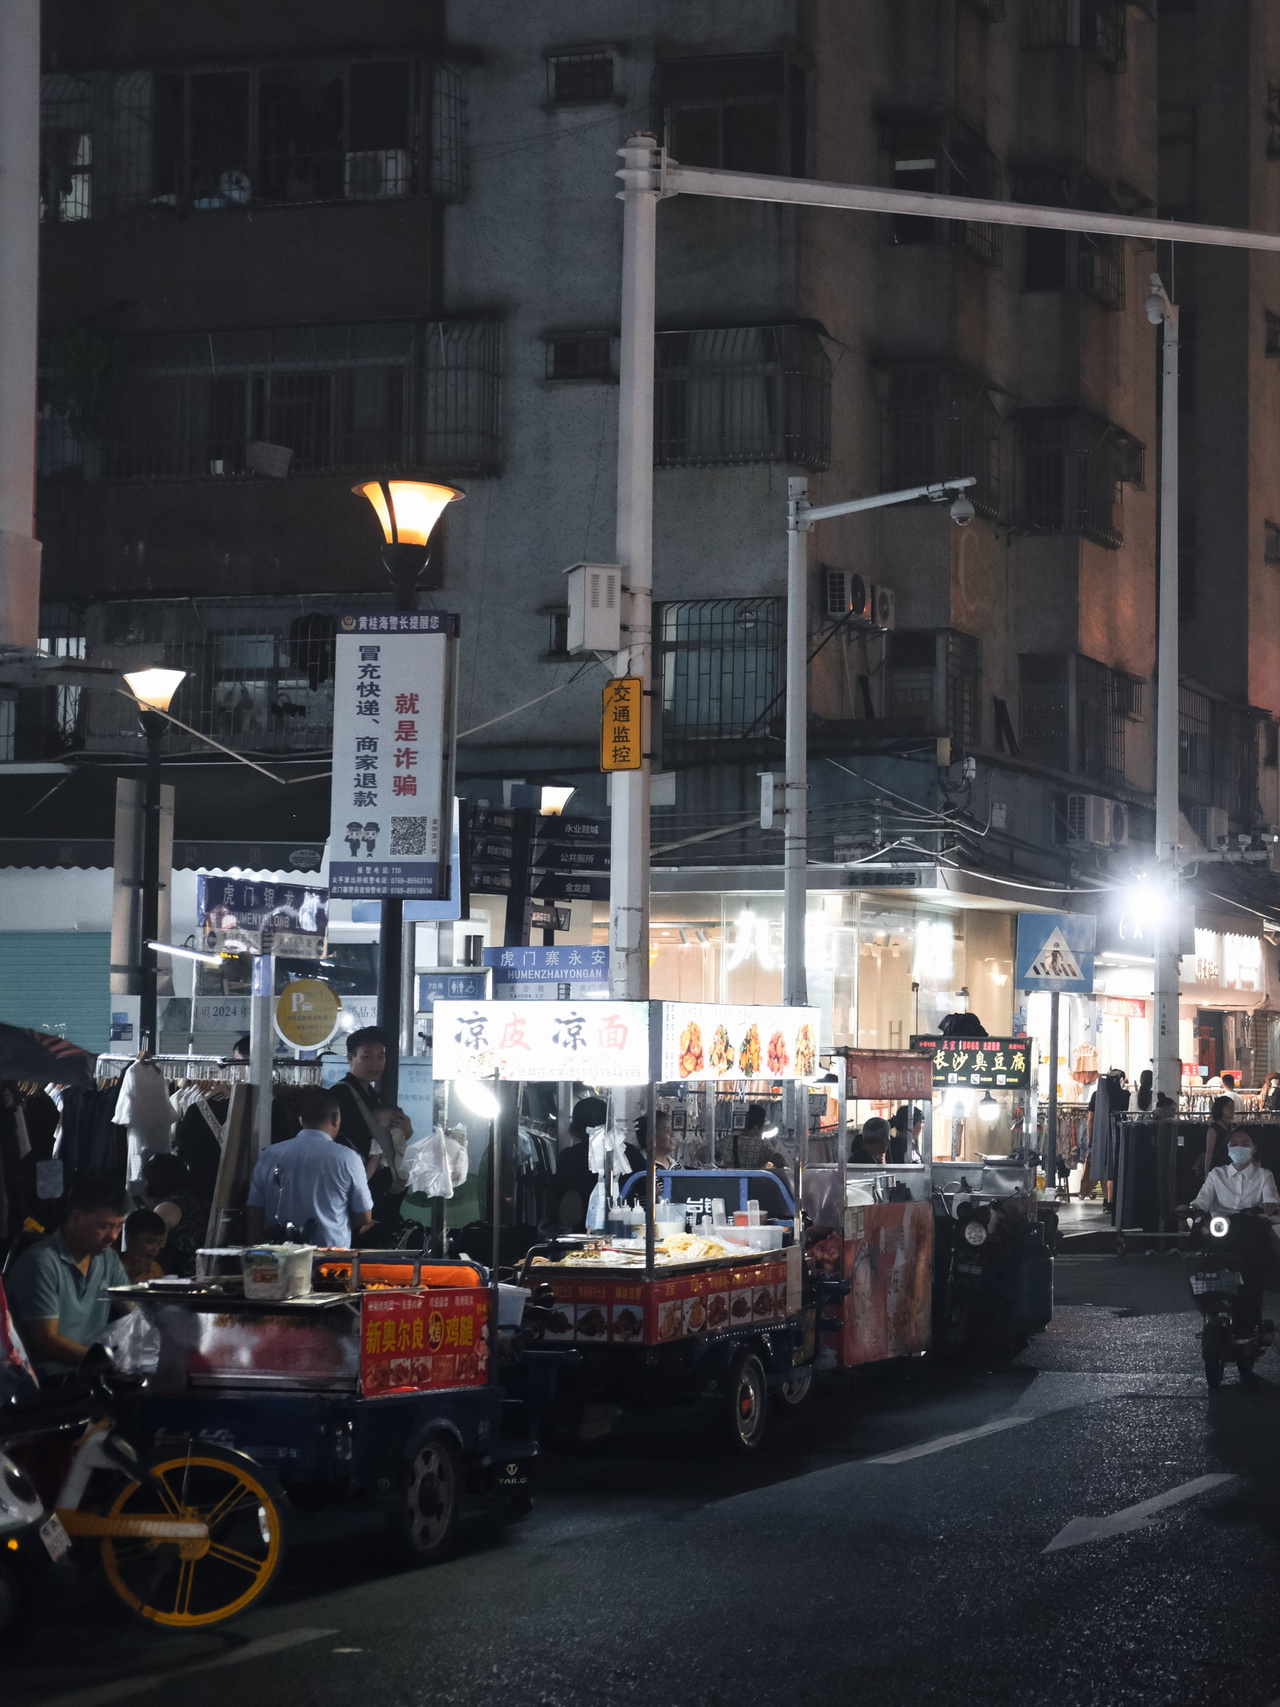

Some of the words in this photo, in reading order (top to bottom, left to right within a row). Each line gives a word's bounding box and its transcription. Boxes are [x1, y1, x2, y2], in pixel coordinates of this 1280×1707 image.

[358, 615, 440, 631] 黄桂海警长提醒您
[353, 645, 381, 807] 冒充快递、商家退款
[612, 685, 631, 763] 交通监控
[392, 693, 420, 796] 就是诈骗
[564, 824, 599, 835] 永业鞋城
[560, 852, 595, 864] 公共厕所
[565, 882, 591, 894] 金龙路
[500, 949, 606, 967] 虎门寨永安
[507, 968, 602, 979] HUMENZHAIYONGAN
[213, 1006, 237, 1017] 2024
[454, 1010, 532, 1051] 凉皮
[552, 1010, 629, 1051] 凉面
[933, 1050, 1026, 1073] 长沙臭豆腐
[366, 1314, 474, 1354] 新奥尔良烤鸡腿
